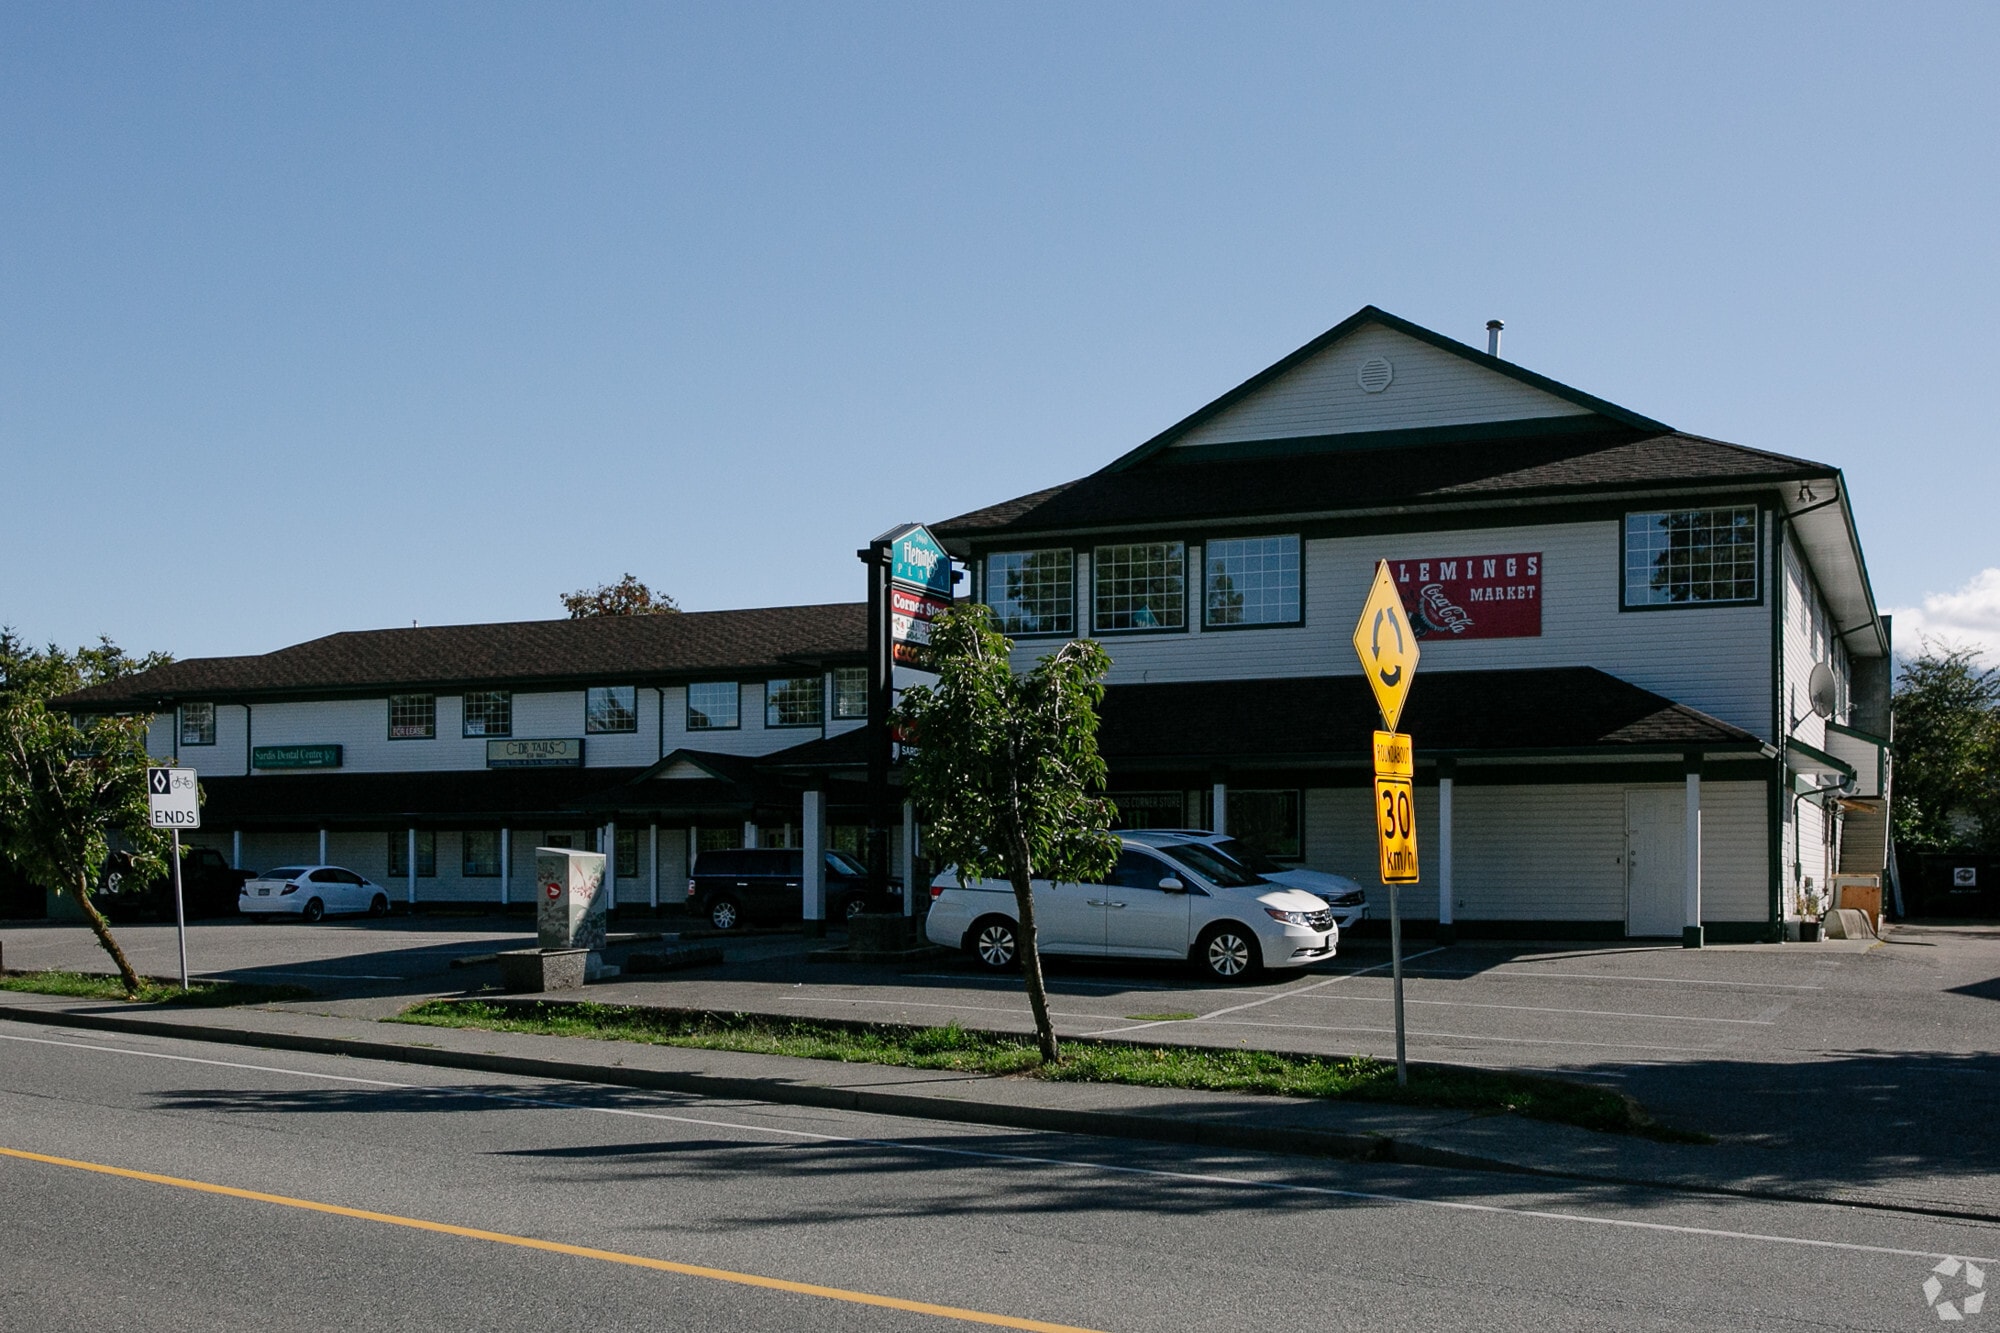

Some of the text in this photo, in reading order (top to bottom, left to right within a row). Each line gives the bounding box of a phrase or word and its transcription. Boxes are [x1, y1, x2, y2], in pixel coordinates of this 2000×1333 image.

[897, 563, 944, 587] PLAA
[1399, 556, 1538, 582] LEMINGS
[1470, 586, 1535, 602] MARKET
[893, 594, 925, 614] Corner
[392, 727, 425, 736] FOR LEASE
[255, 748, 323, 760] Sardis Dental Centre
[518, 742, 529, 755] DE
[531, 741, 555, 754] TAILS
[1376, 743, 1409, 764] ROUNDABOUT
[1131, 797, 1158, 808] CORNER
[1160, 796, 1180, 808] STORE
[155, 810, 195, 823] ENDS
[1382, 789, 1410, 839] 30
[1386, 845, 1414, 872] km/h
